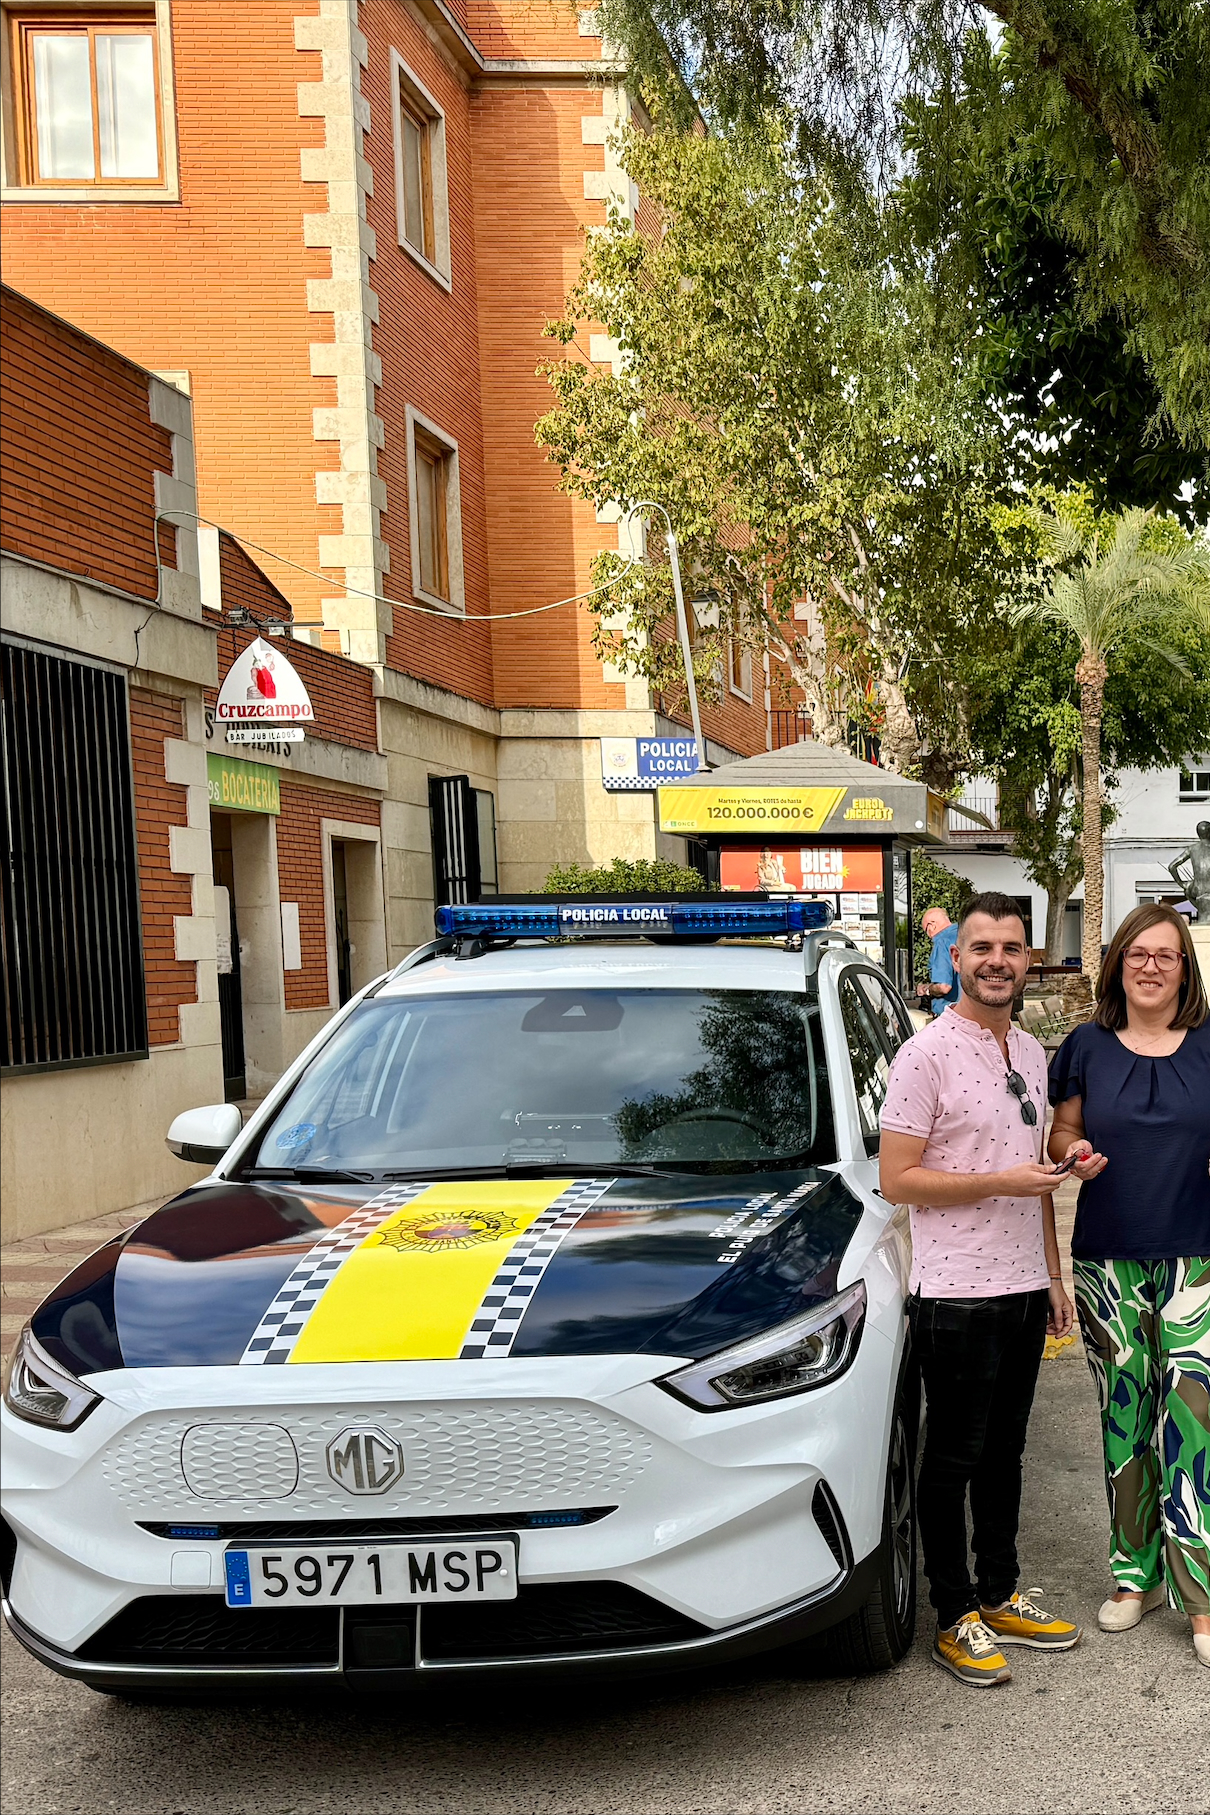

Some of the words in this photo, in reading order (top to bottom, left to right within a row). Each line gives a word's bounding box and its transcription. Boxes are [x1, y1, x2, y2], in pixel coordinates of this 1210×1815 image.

[218, 703, 311, 719] Cruzcampo
[251, 730, 296, 740] JUBILADOS
[640, 742, 698, 757] POLICIA
[650, 760, 691, 771] LOCAL
[222, 770, 279, 809] BOCATERÍA
[852, 798, 881, 809] EURO
[800, 848, 843, 873] BIEN
[802, 874, 843, 890] JUGADO
[562, 909, 618, 921] POLICIA
[623, 908, 668, 920] LOCAL
[708, 1211, 753, 1238] POLICIA
[741, 1192, 778, 1210] LOCAL
[761, 1198, 799, 1218] SANTA
[749, 1218, 773, 1228] DE
[729, 1229, 760, 1248] PUIG
[717, 1251, 742, 1263] EL
[333, 1432, 396, 1489] MG
[234, 1584, 245, 1596] E
[261, 1553, 382, 1597] 5971
[408, 1550, 501, 1594] MSP
